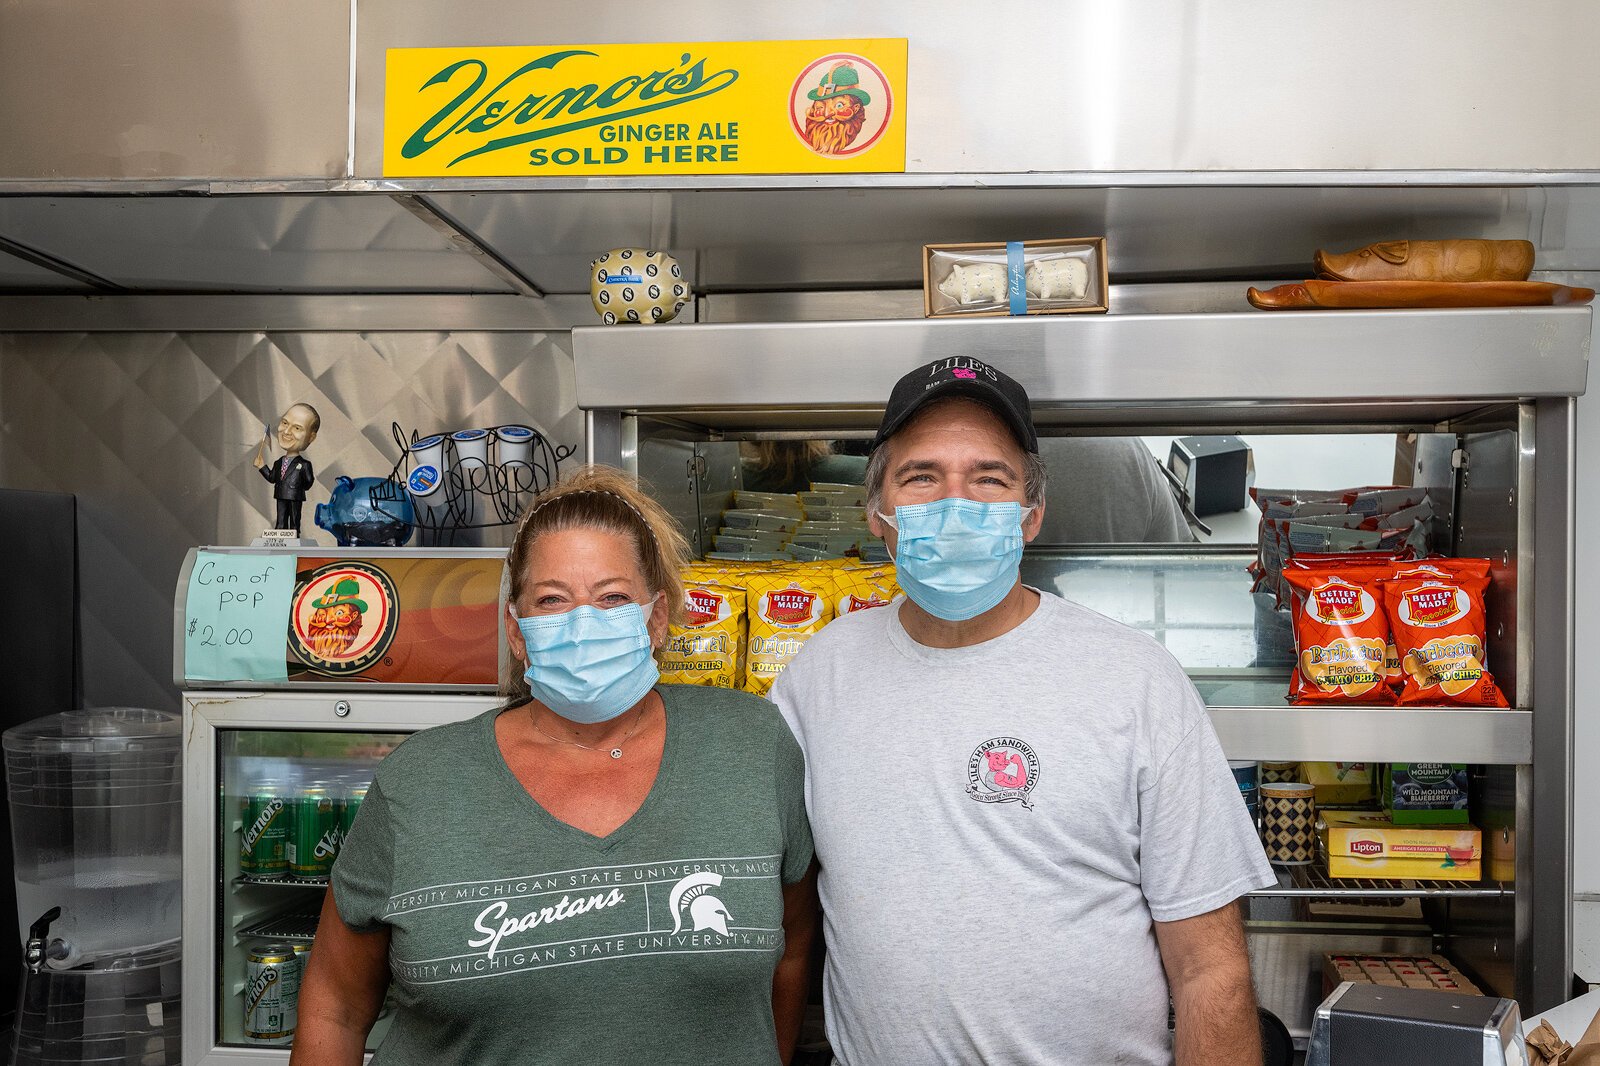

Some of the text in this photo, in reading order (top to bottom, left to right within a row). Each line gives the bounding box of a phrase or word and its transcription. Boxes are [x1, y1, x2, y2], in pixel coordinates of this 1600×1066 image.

[402, 51, 739, 168] Vernor's
[599, 122, 739, 143] GINGER ALE
[529, 144, 738, 166] SOLD HERE
[929, 357, 997, 382] LILE'S
[198, 561, 275, 585] Can of
[220, 591, 264, 611] pop
[773, 594, 810, 603] BETTER
[1319, 589, 1357, 598] BETTER
[1326, 597, 1353, 605] MADE
[1412, 591, 1452, 602] BETTER
[777, 601, 805, 610] MADE
[1418, 599, 1448, 609] MADE
[767, 607, 810, 625] Special
[1413, 602, 1455, 626] Special
[695, 660, 722, 671] CHIPS
[1328, 663, 1369, 675] Flavored
[1427, 660, 1467, 674] Flavored
[1452, 669, 1481, 681] CHIPS
[970, 739, 1038, 792] LILE'S HAM SANDWICH SHOP
[1411, 768, 1450, 776] MOUNTAIN
[1421, 788, 1459, 796] MOUNTAIN
[240, 795, 284, 854] Vernors
[1353, 843, 1381, 853] Lipton
[456, 878, 558, 899] MICHIGAN
[569, 871, 622, 886] STATE
[634, 863, 736, 880] UNIVERSITY
[467, 888, 624, 960] Spartans
[449, 948, 556, 975] MICHIGAN
[569, 940, 624, 957] STATE
[638, 932, 747, 949] UNIVERSITY
